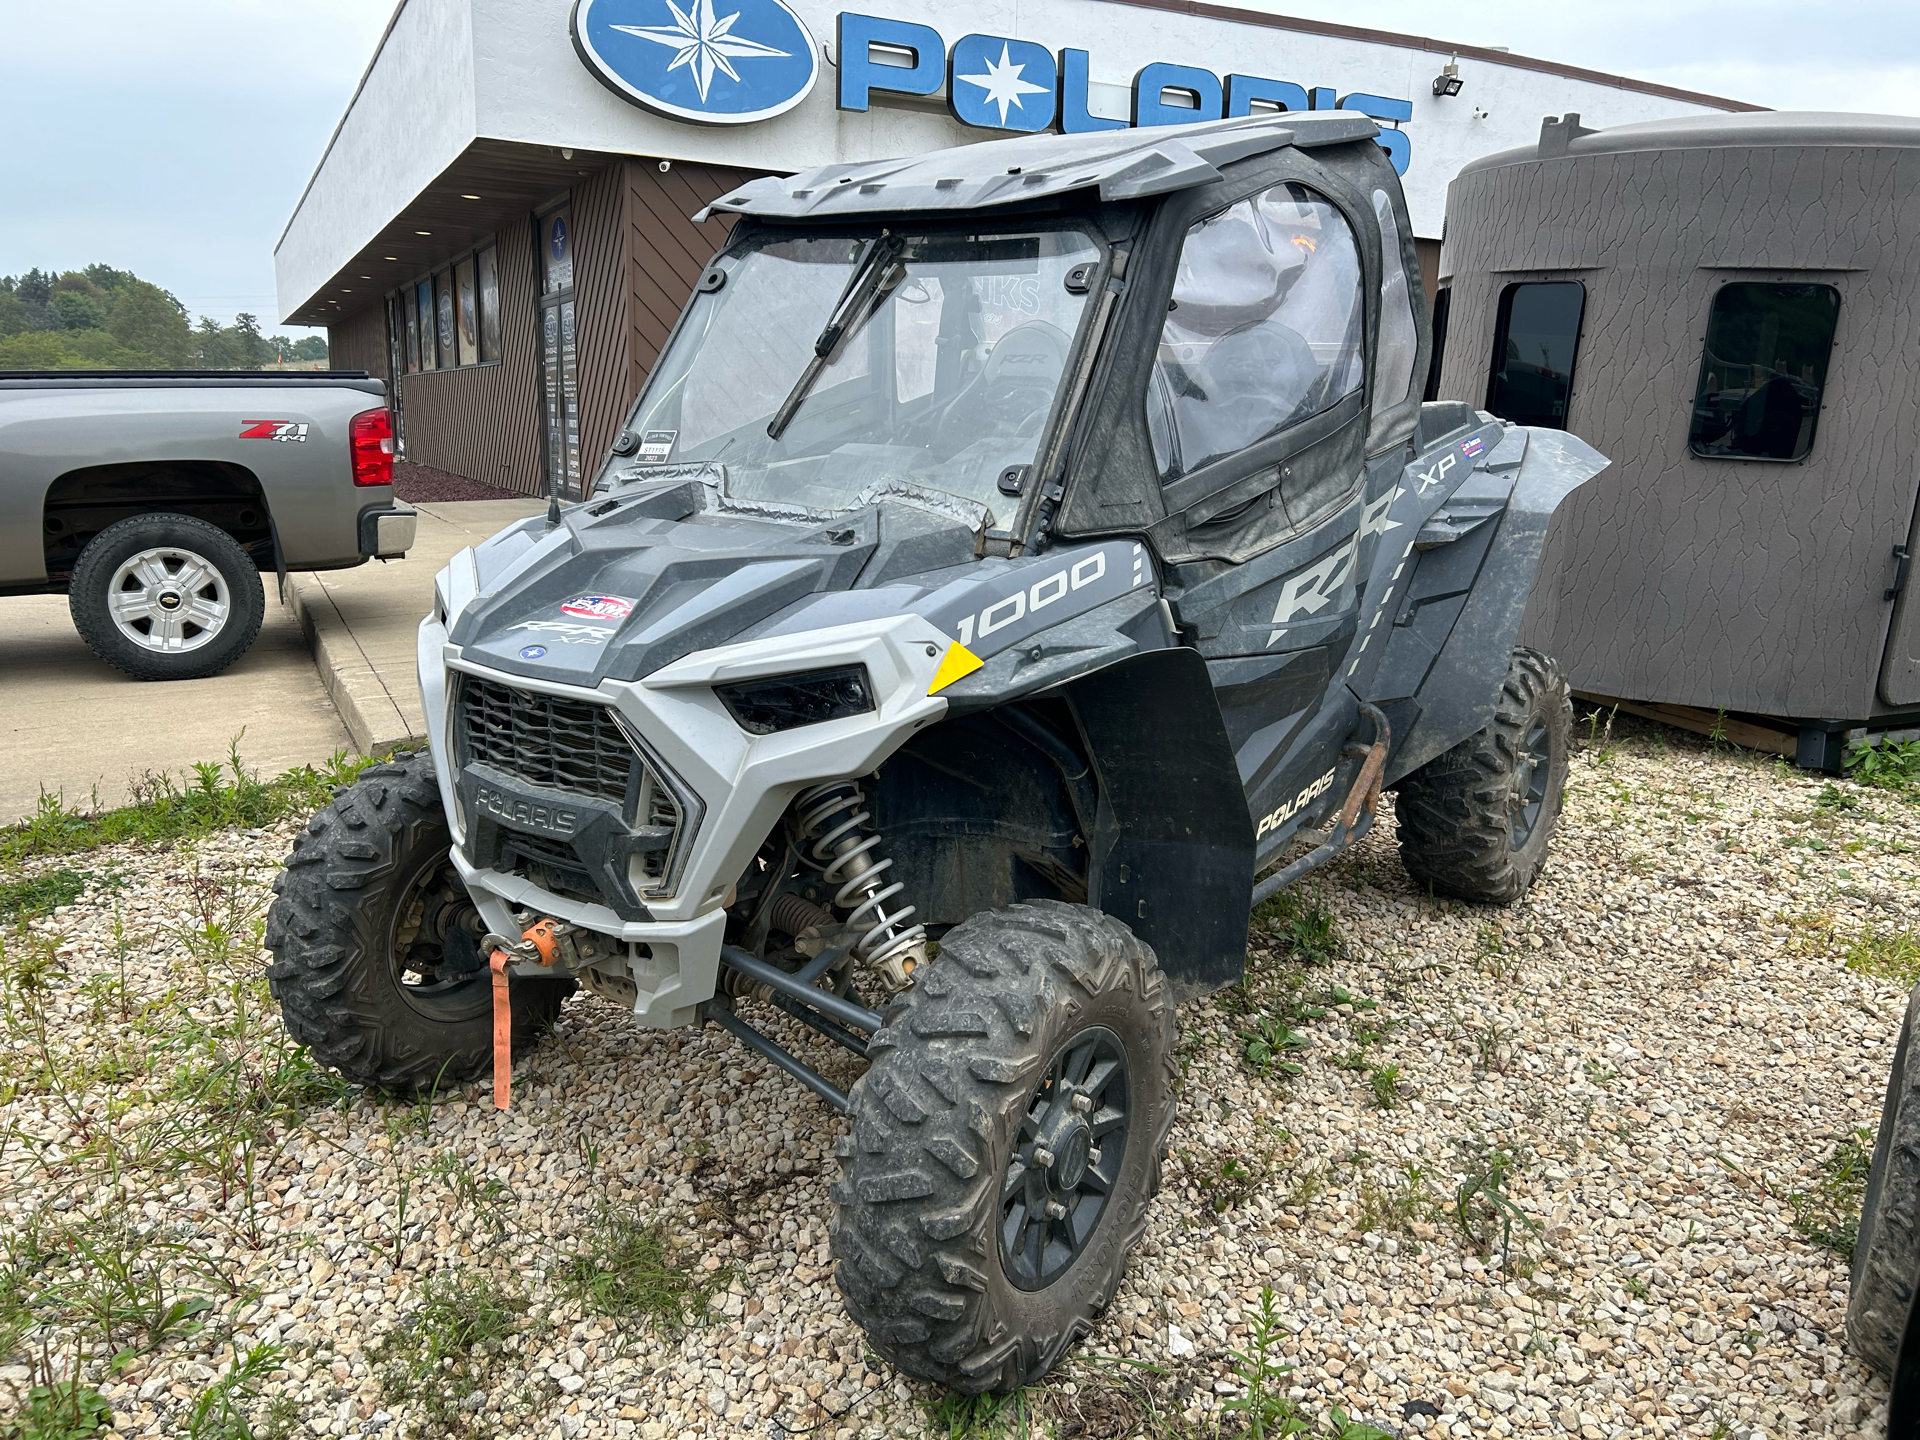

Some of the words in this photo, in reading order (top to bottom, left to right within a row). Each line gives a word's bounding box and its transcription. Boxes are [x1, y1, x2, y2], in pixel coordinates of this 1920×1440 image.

[836, 12, 1412, 176] POLARS
[998, 353, 1048, 366] RZR
[238, 419, 309, 439] Z71
[1265, 484, 1406, 648] RZR
[1416, 452, 1456, 495] XP
[956, 550, 1106, 647] 1000
[505, 620, 618, 639] RZR
[550, 635, 604, 645] XP
[475, 784, 577, 834] POLARIS
[1255, 766, 1336, 841] POLARIS
